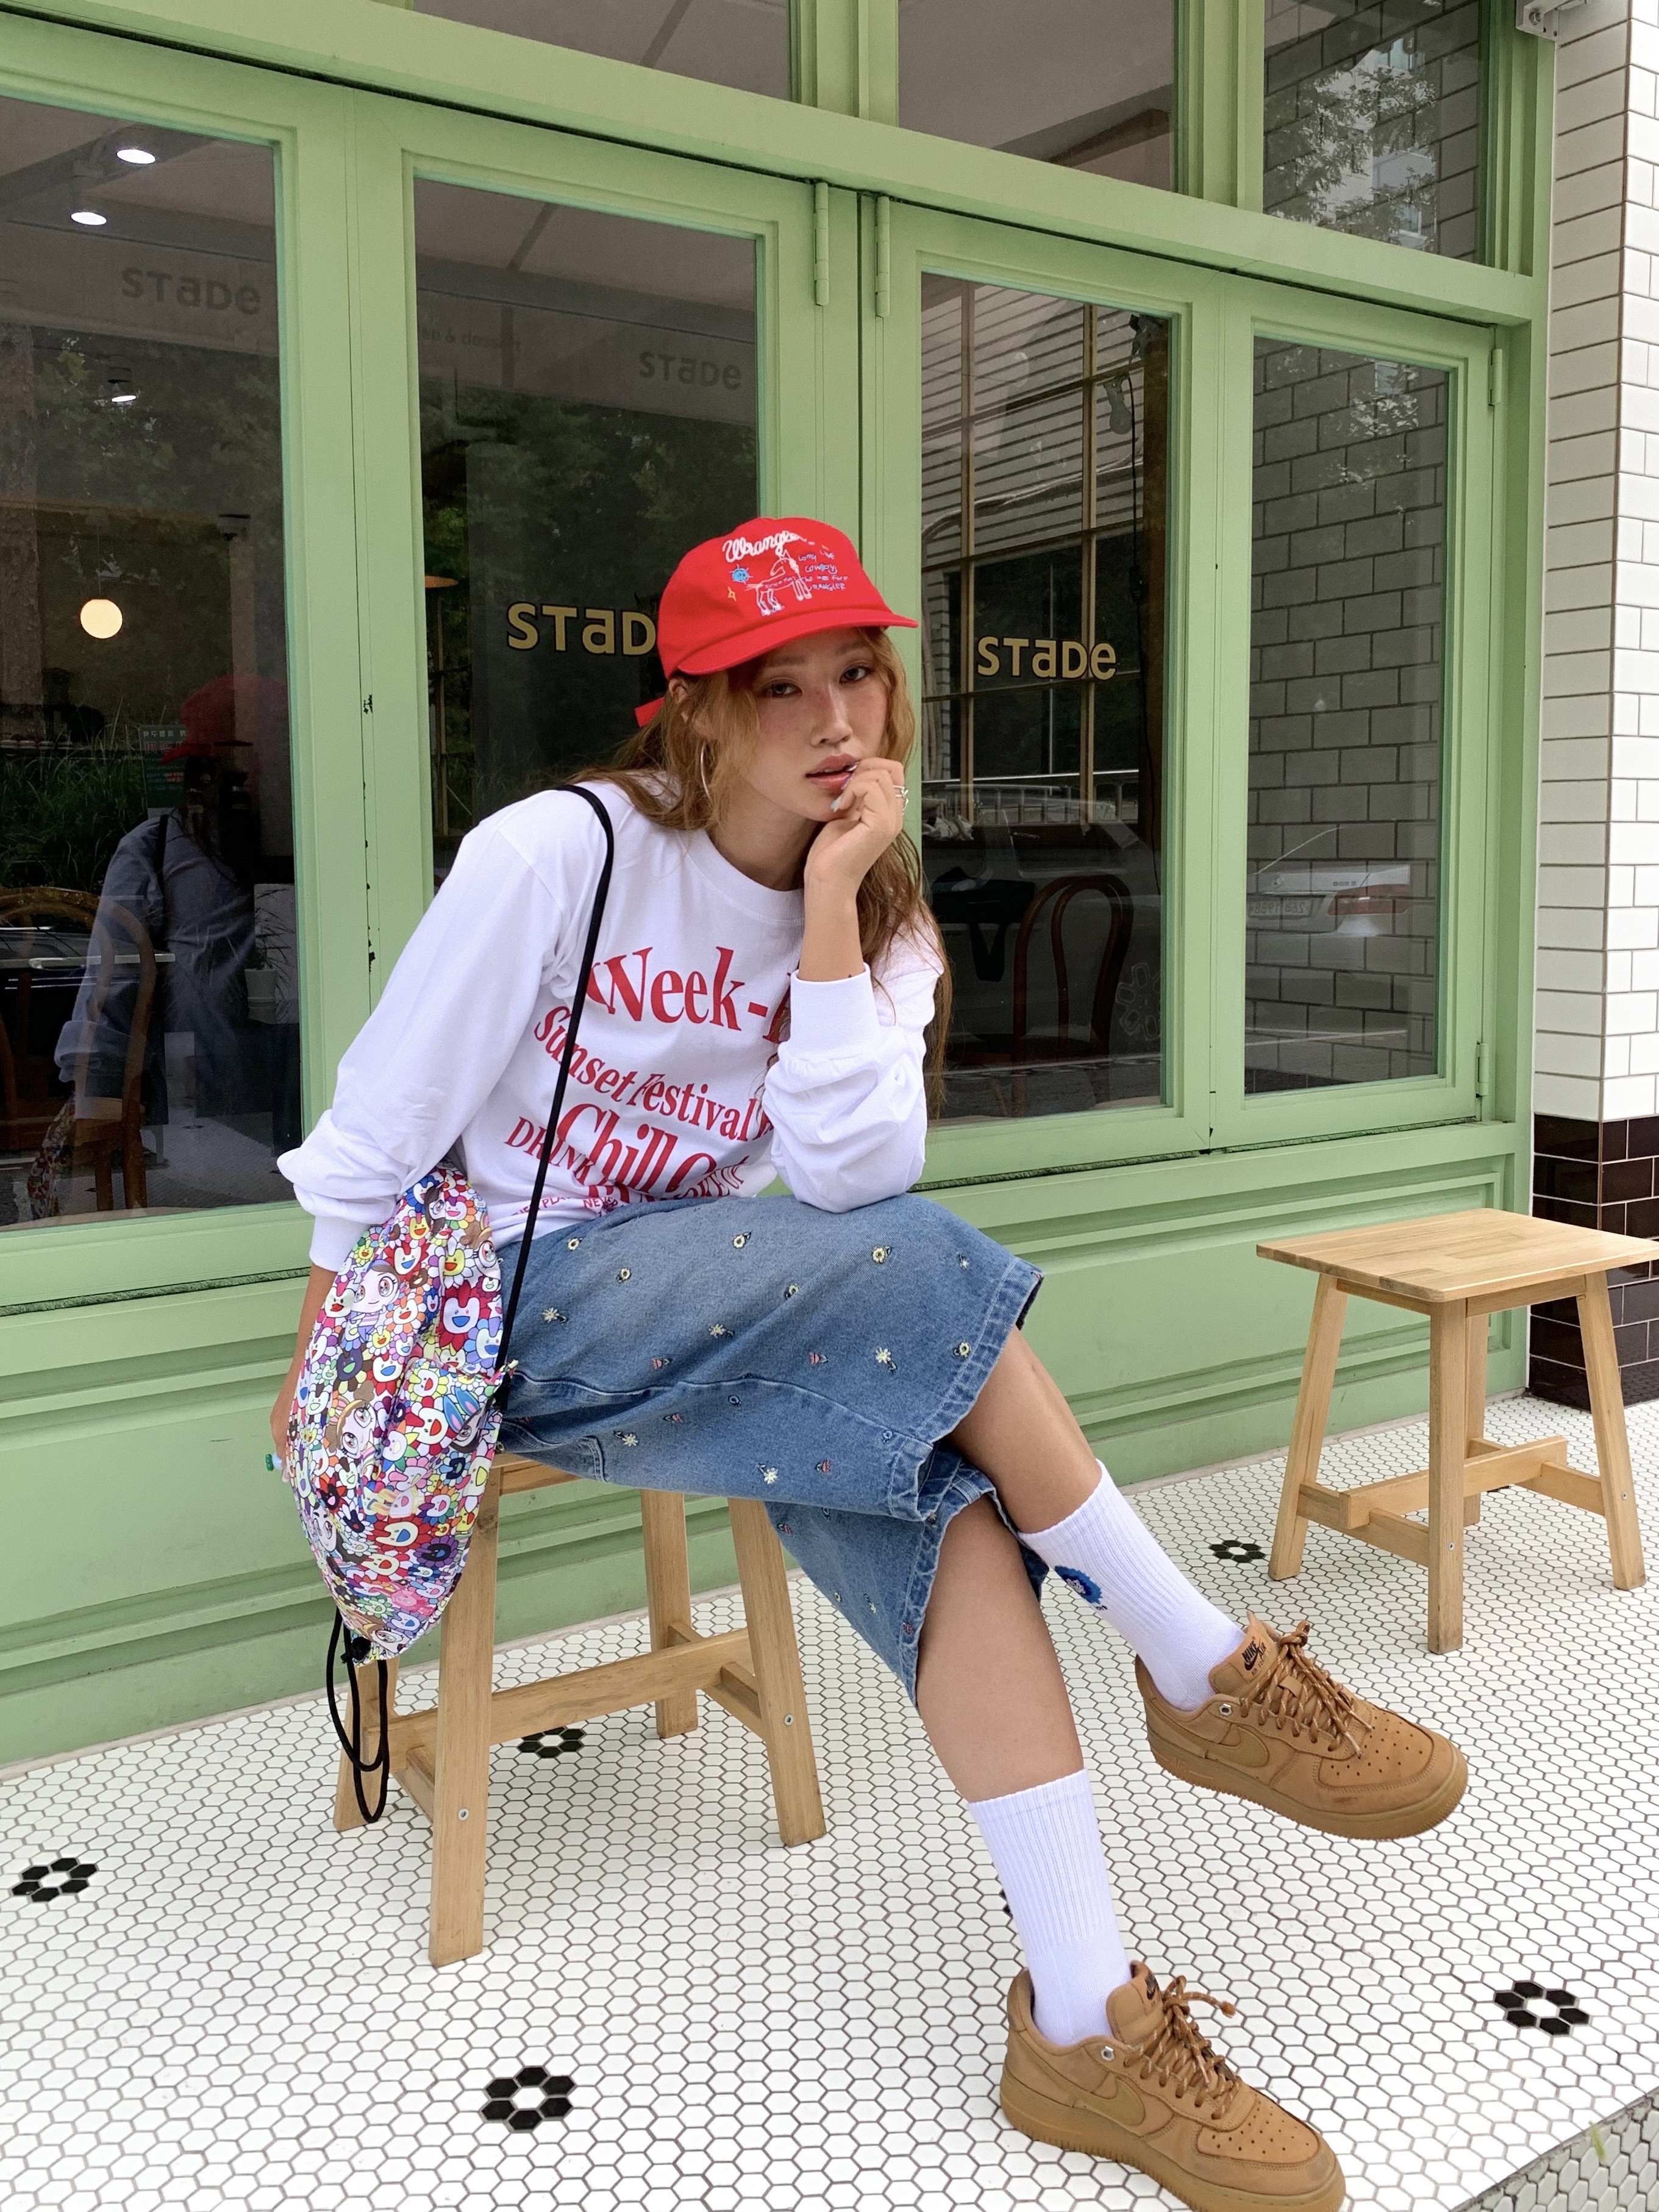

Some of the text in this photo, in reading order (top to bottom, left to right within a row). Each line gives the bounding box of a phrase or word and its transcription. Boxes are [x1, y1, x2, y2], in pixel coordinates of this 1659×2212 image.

[534, 1005, 757, 1141] Sunset Festival
[1241, 1640, 1257, 1663] NIKE
